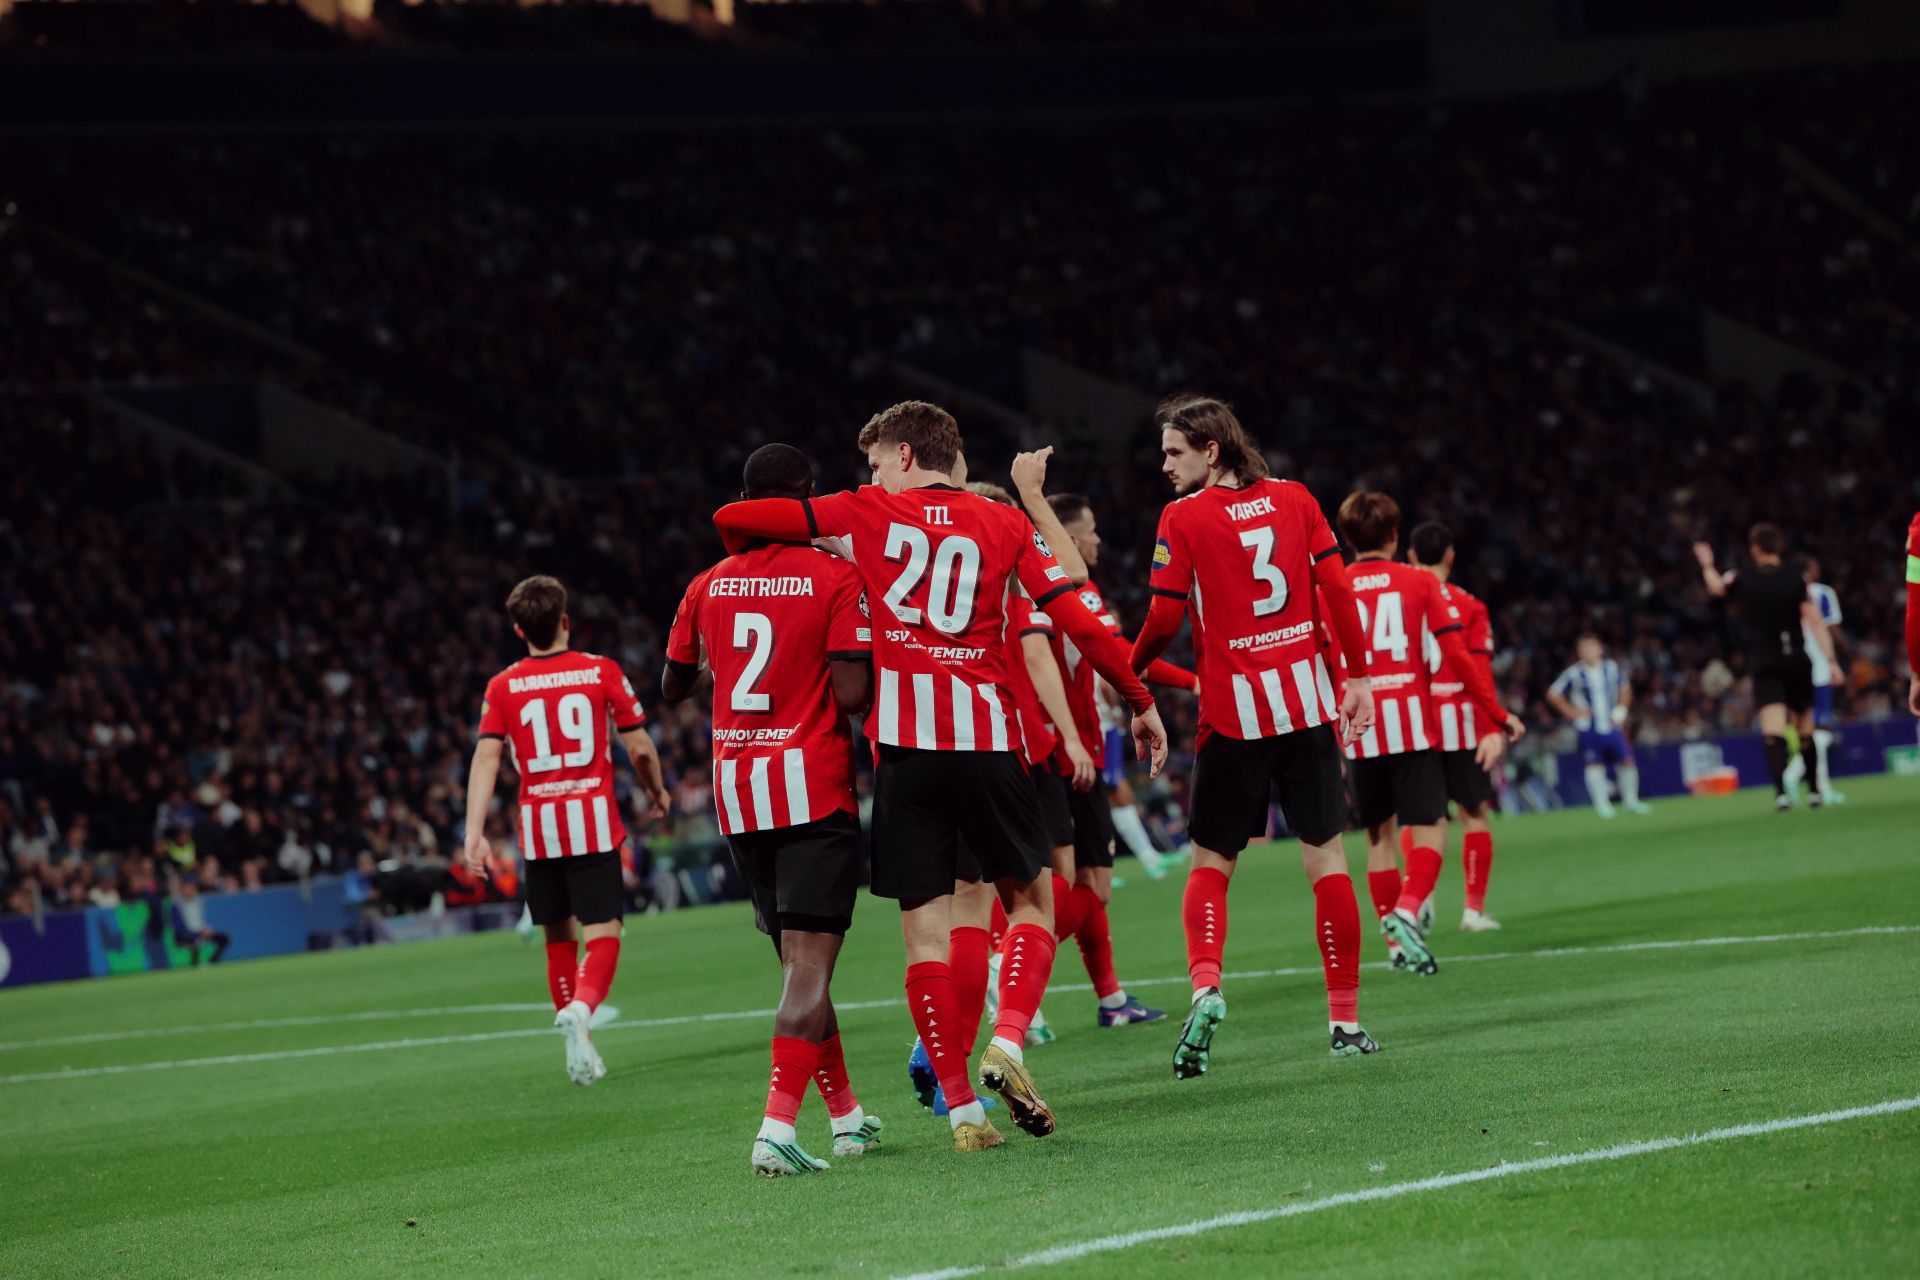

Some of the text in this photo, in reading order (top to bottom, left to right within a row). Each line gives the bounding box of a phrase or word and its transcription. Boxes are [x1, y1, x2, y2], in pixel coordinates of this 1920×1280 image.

[923, 505, 953, 525] TIL
[1224, 496, 1276, 521] YAREK
[882, 521, 980, 635] 20
[1239, 525, 1288, 617] 3
[1352, 572, 1391, 592] SANO
[708, 577, 814, 597] GEERTRUIDA
[1229, 621, 1314, 650] PSV MOVEMEN
[731, 612, 773, 711] 2
[520, 693, 595, 773] 19
